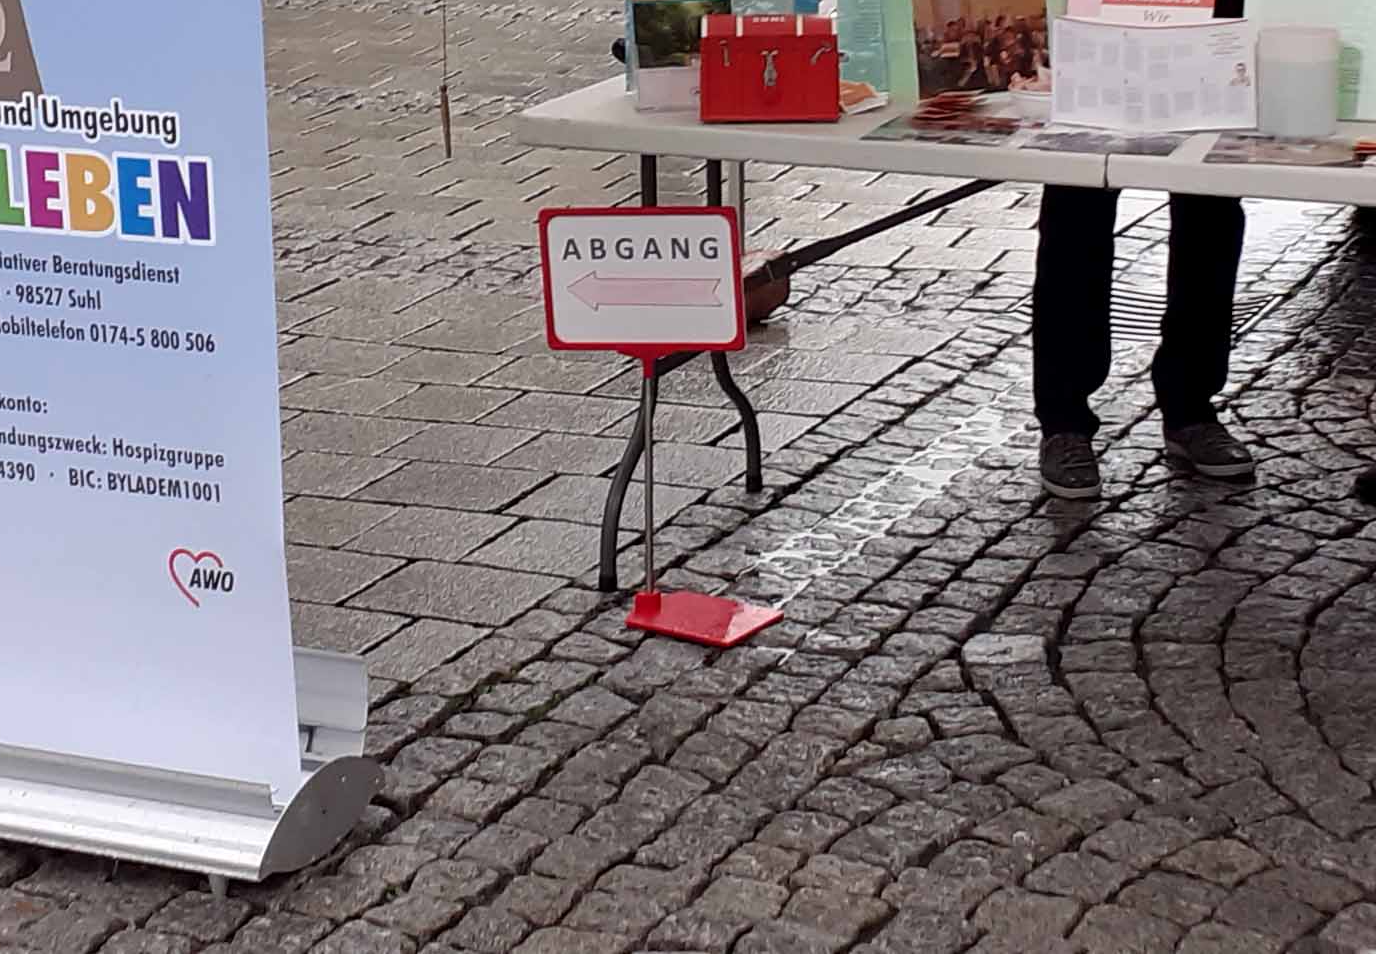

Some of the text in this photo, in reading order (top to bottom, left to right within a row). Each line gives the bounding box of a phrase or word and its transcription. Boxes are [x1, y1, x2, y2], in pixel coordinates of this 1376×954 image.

[43, 101, 177, 142] Umgebung
[562, 237, 720, 260] ABGANG
[53, 255, 180, 285] Beratungsdienst
[15, 285, 63, 307] 98527
[68, 289, 102, 311] Suhl
[90, 323, 145, 348] 0174-5
[150, 329, 180, 351] 800
[185, 333, 215, 354] 506
[112, 437, 224, 471] Hospizgruppe
[68, 467, 102, 490] BIC:
[107, 473, 222, 503] BYLADEM1001
[189, 568, 235, 592] AWO
